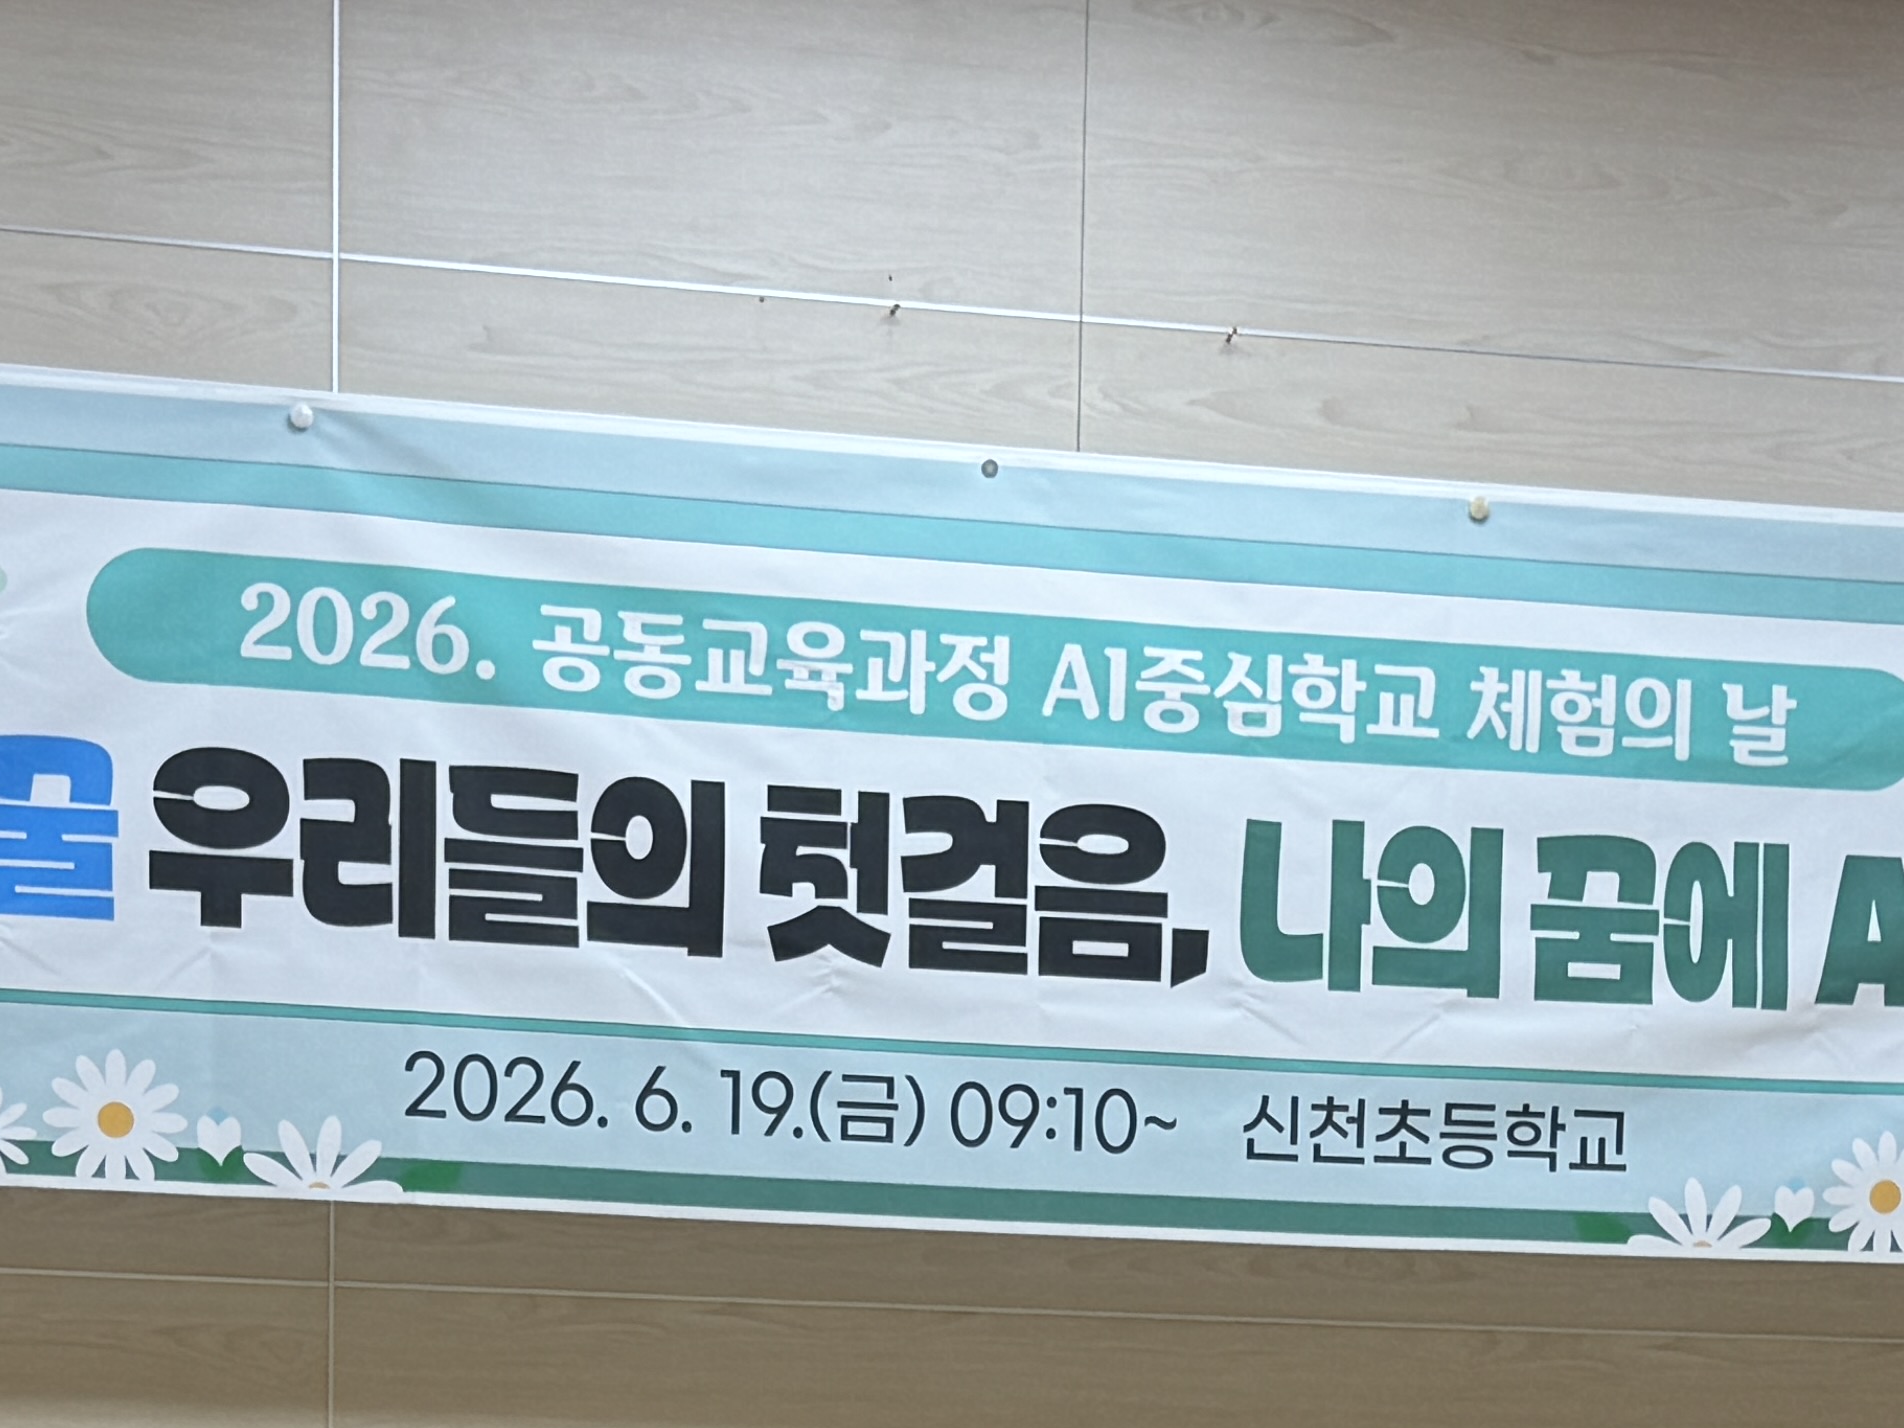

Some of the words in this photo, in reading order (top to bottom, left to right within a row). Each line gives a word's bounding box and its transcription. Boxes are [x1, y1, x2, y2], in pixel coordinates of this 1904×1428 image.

[239, 582, 496, 681] 2026.
[531, 603, 1011, 721] 공동교육과정
[1042, 643, 1439, 744] AI중심학교
[1467, 665, 1693, 762] 체험의
[1722, 681, 1798, 767] 날
[149, 747, 725, 958] 우리들의
[760, 785, 1209, 987] 첫걸음,
[1240, 819, 1504, 999] 나의
[1531, 834, 1790, 1011] 꿈에
[404, 1050, 608, 1128] 2026.
[950, 1081, 1177, 1154] 09:10~
[1243, 1094, 1628, 1172] 신천초등학교
